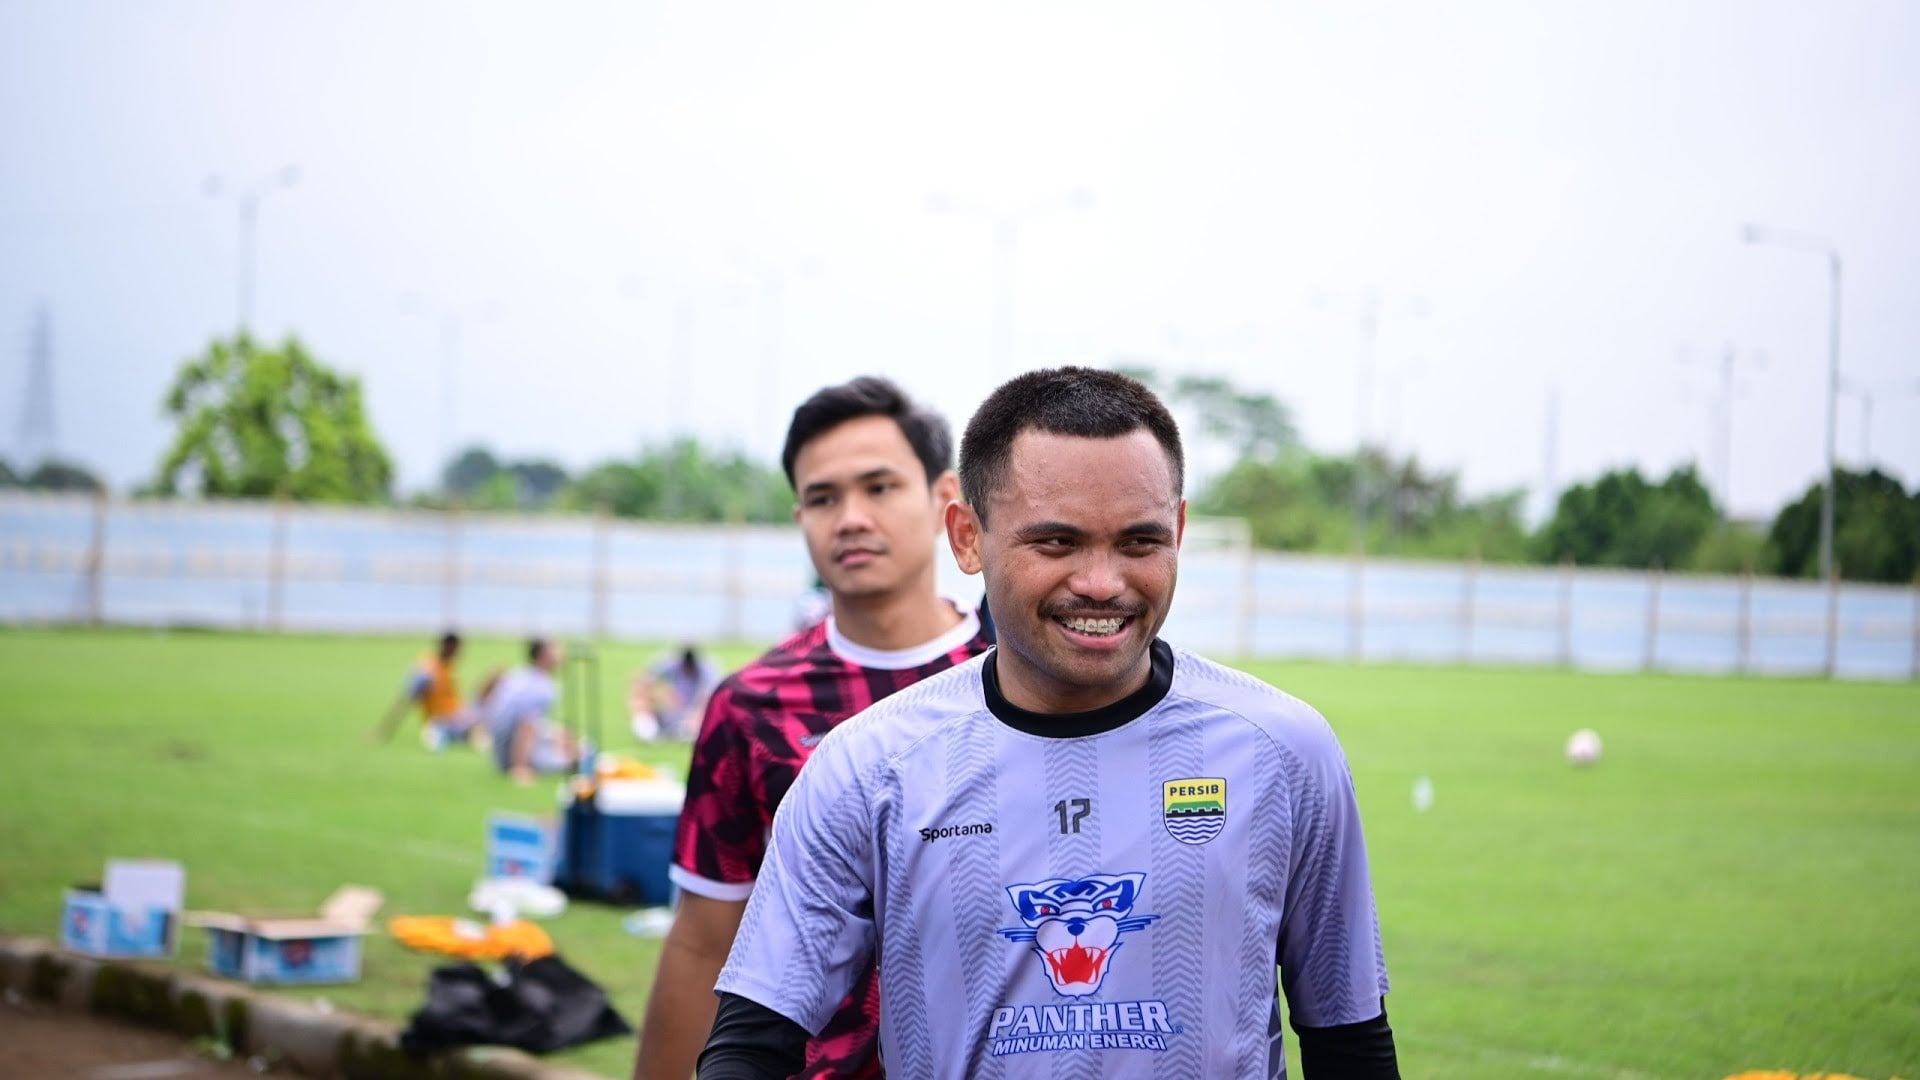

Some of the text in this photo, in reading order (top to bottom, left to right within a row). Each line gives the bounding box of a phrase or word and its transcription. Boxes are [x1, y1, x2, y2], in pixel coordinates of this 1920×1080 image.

[1169, 784, 1220, 797] PERSIB
[1054, 798, 1090, 834] 17
[919, 822, 993, 843] Sportama
[987, 1000, 1174, 1038] PANTHER
[992, 1033, 1167, 1056] MINUMAN ENERGI
